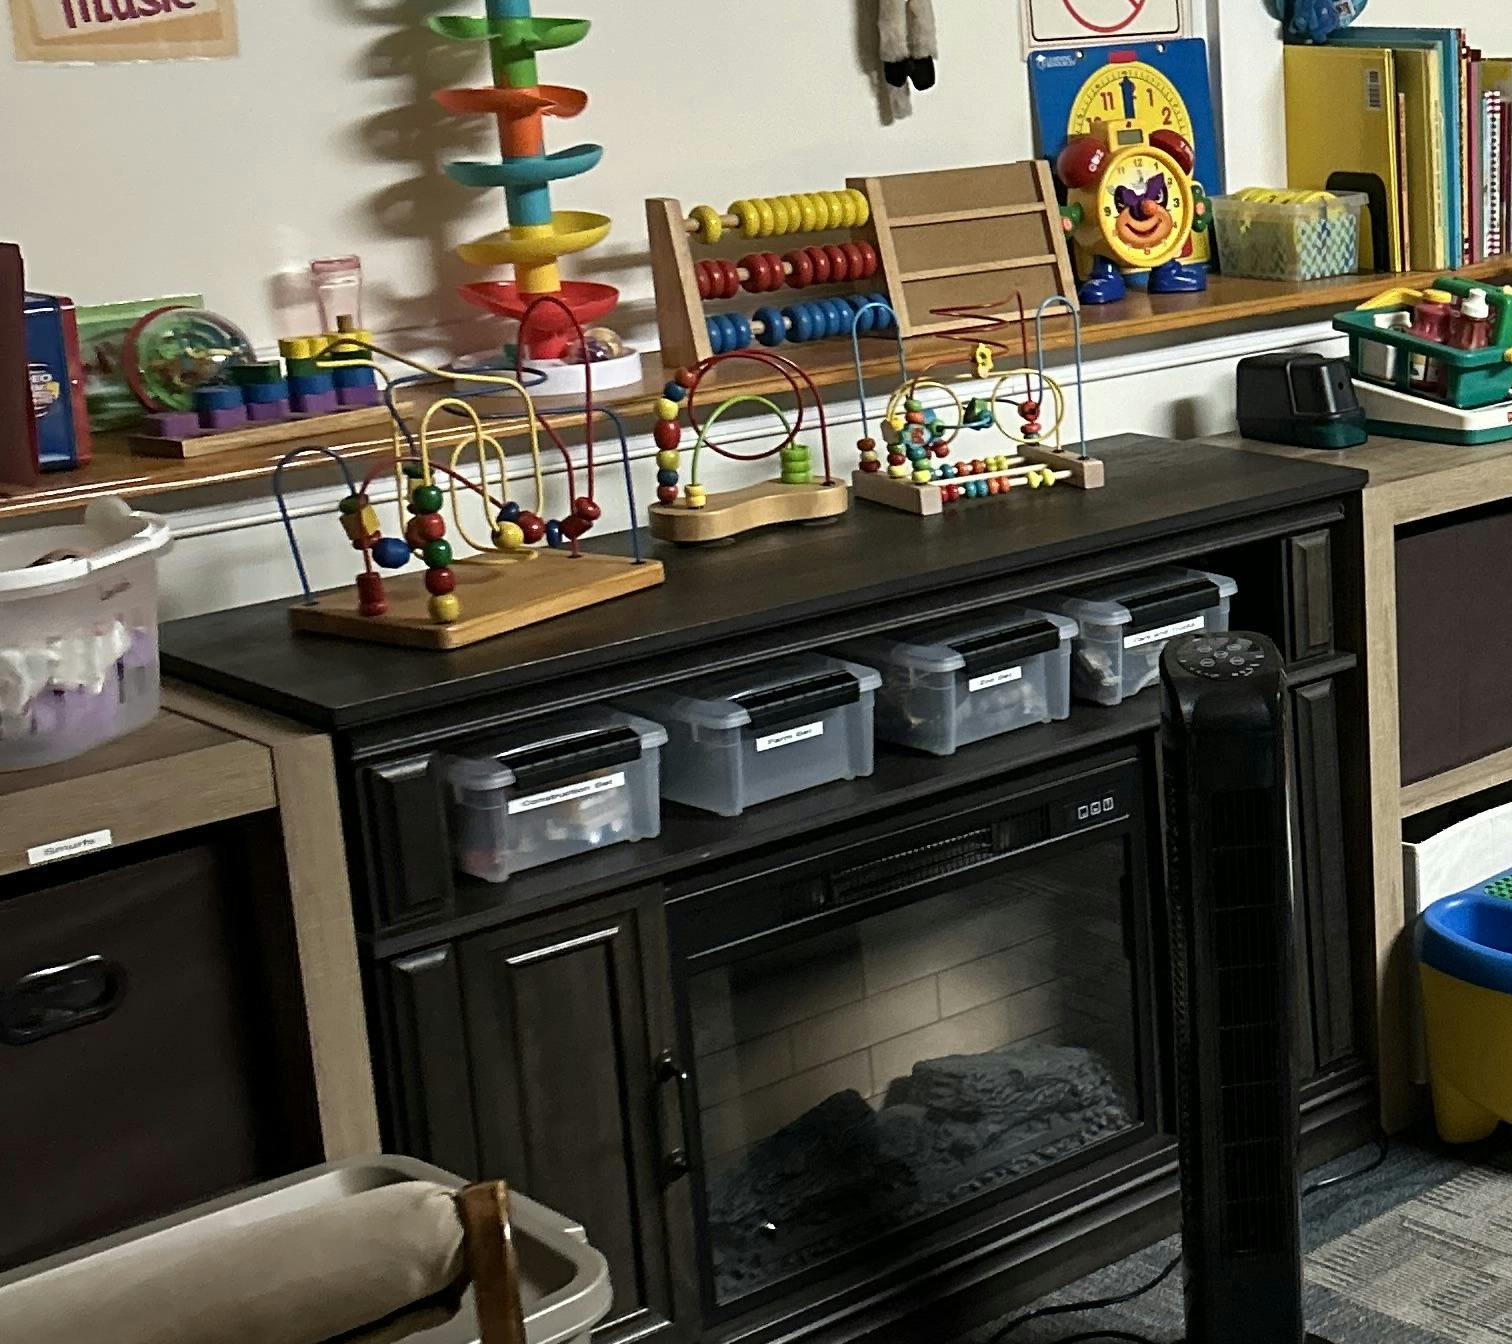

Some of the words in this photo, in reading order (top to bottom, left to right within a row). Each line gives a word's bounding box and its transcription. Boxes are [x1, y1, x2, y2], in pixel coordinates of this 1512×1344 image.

[1100, 91, 1115, 111] 11
[1146, 88, 1154, 107] 1
[1162, 107, 1172, 125] 2
[1173, 198, 1180, 207] 3
[521, 786, 590, 806] Construction
[594, 779, 613, 789] Set
